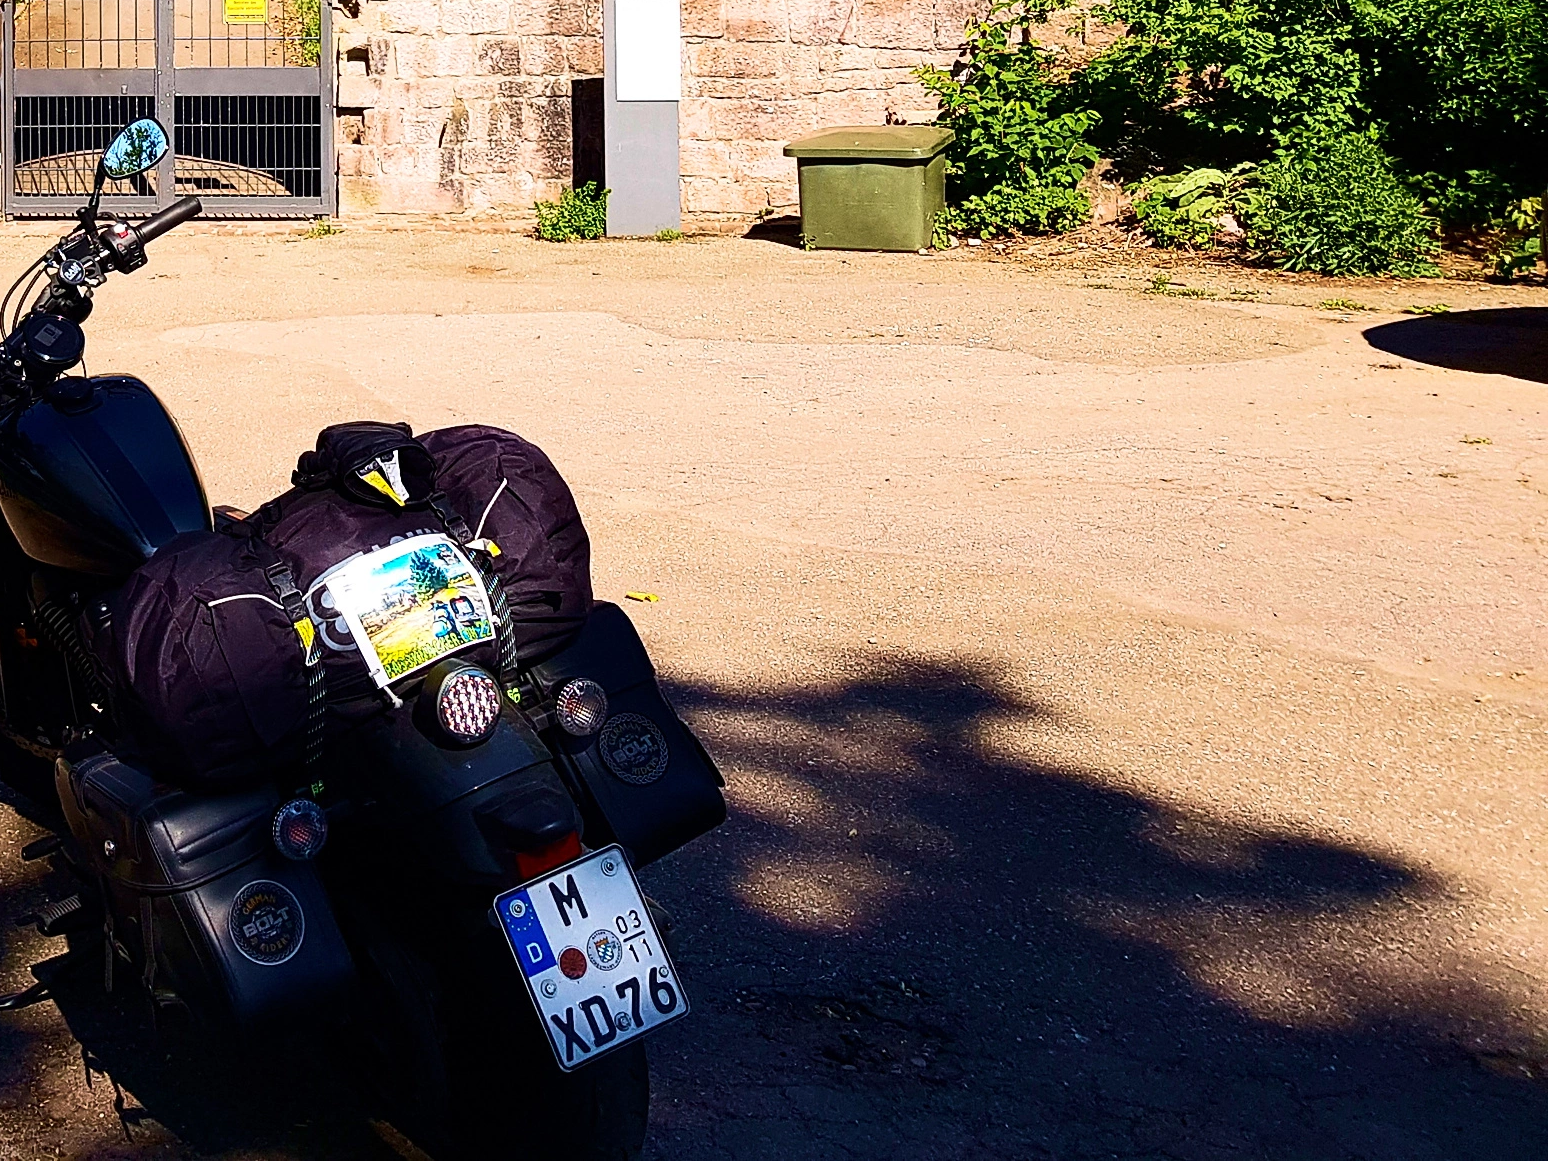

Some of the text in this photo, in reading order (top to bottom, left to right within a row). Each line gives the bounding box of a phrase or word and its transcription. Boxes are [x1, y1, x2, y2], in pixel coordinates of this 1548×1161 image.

[242, 893, 276, 915] GERMAN
[549, 874, 588, 927] M
[242, 906, 289, 938] BOLT
[615, 909, 642, 934] 03
[526, 942, 543, 964] D
[628, 938, 653, 963] 11
